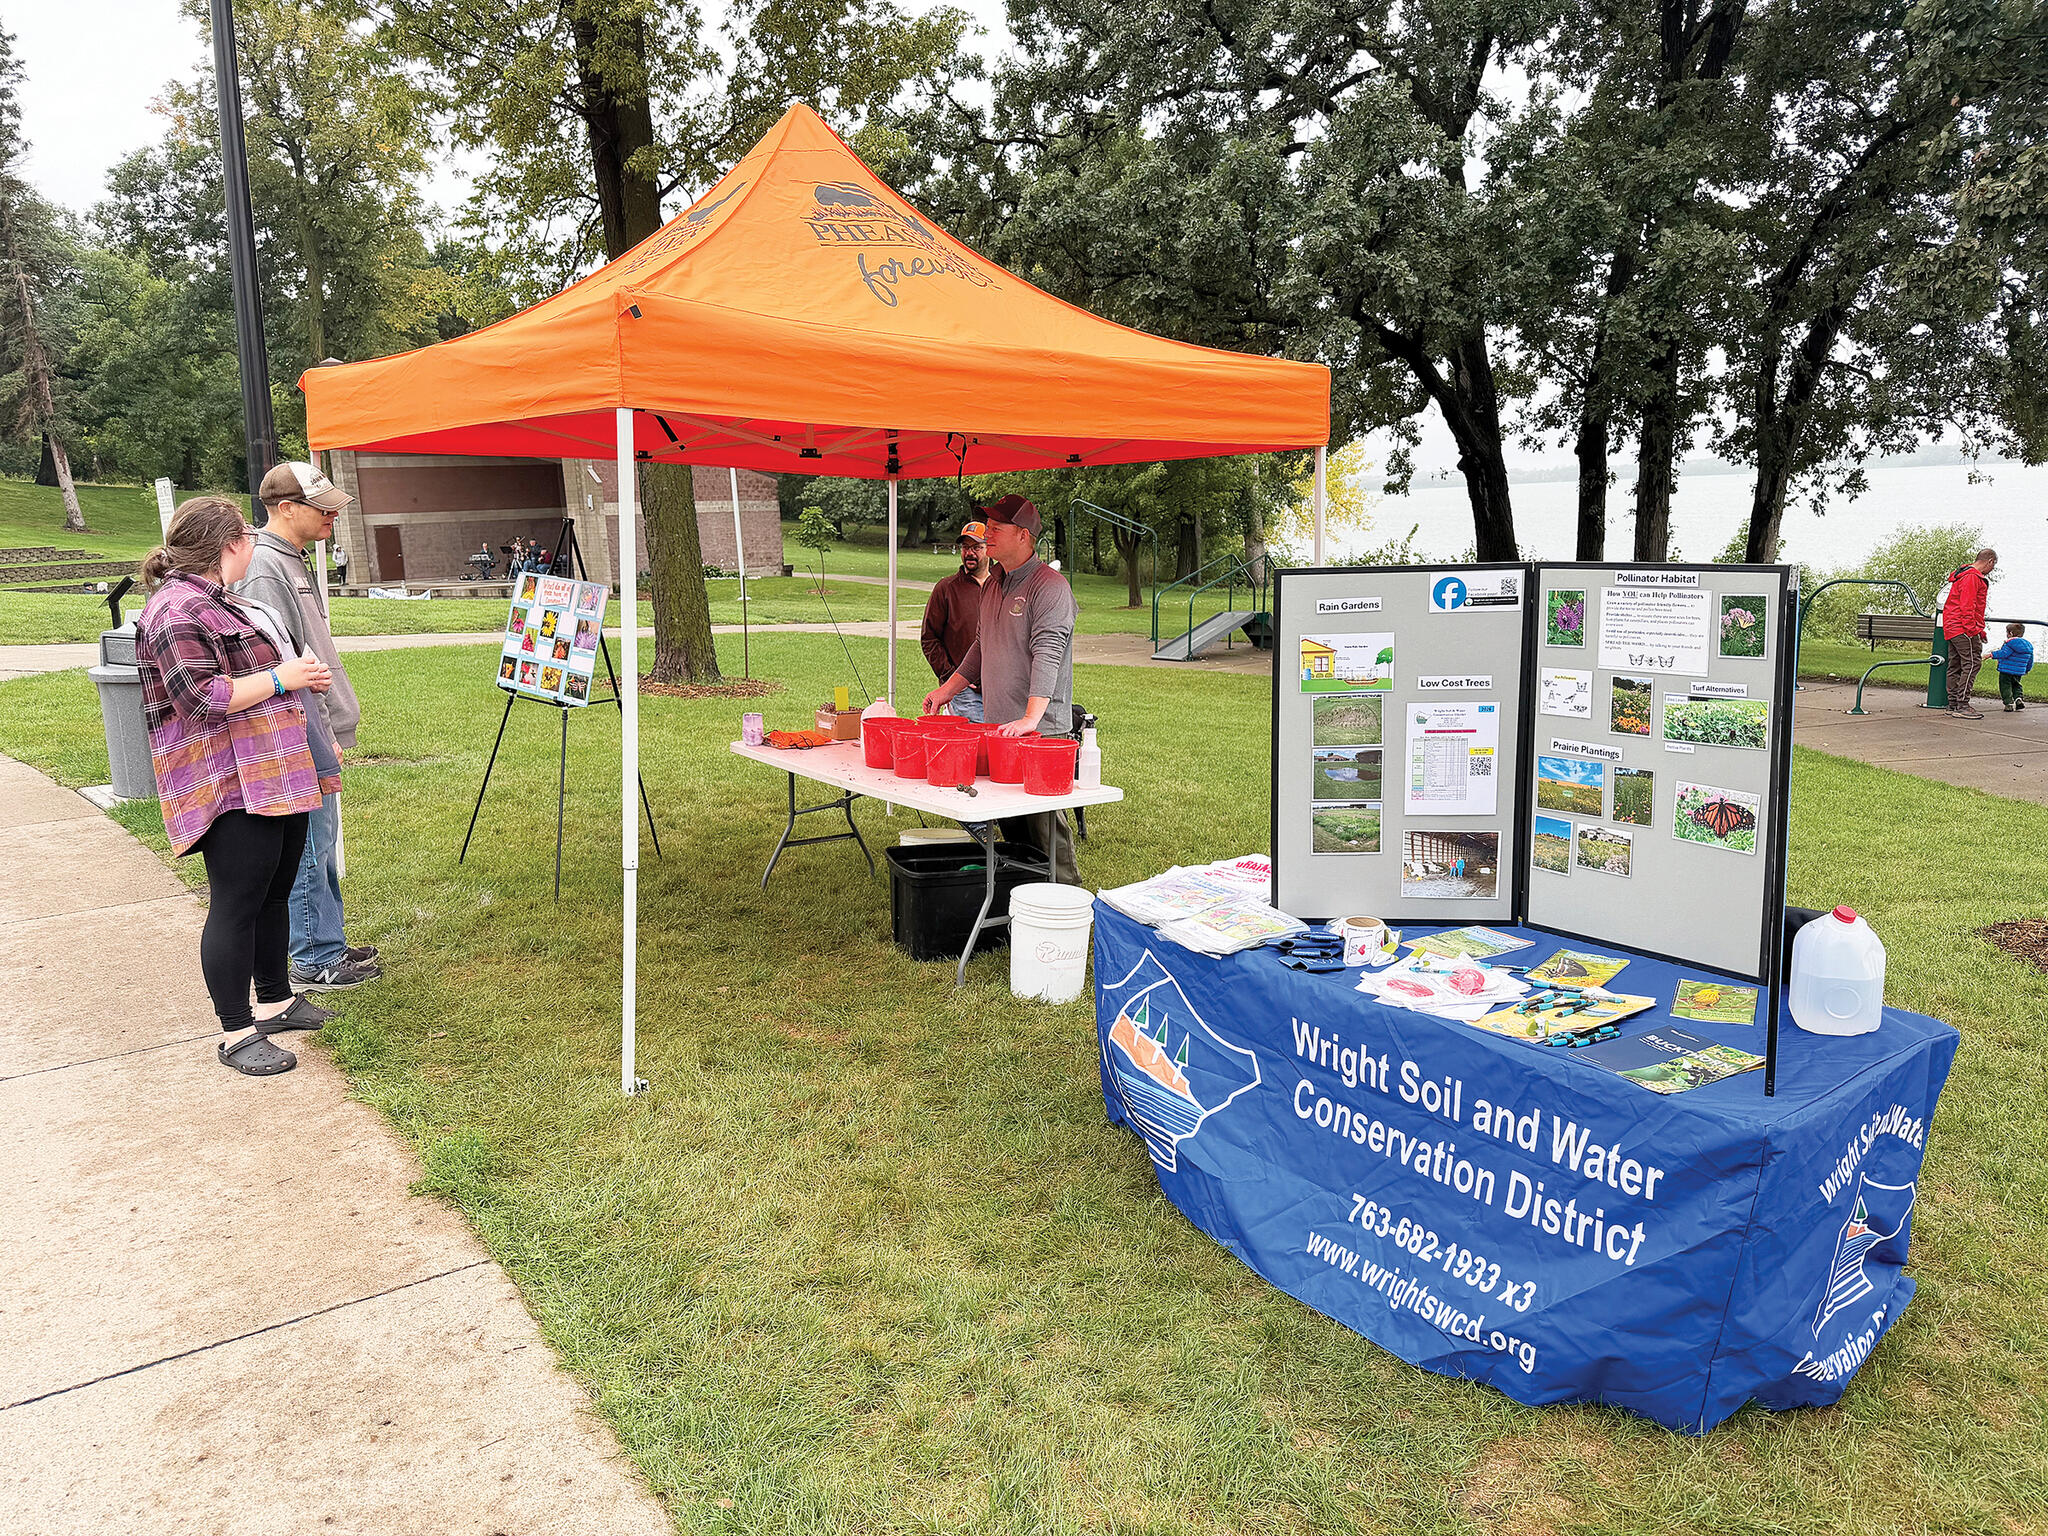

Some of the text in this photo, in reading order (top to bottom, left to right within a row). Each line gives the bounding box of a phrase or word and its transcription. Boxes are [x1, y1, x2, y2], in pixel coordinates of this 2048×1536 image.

[1616, 573, 1697, 585] Pollinator Habitat
[1622, 590, 1639, 598] YOU
[1652, 592, 1668, 600] Help
[1319, 600, 1380, 612] Rain Gardens
[1420, 678, 1491, 688] Low Cost Trees
[1705, 686, 1745, 694] Alternatives
[1553, 740, 1620, 760] Prairie Plantings
[314, 968, 340, 984] N
[1646, 1034, 1737, 1070] BUCKTHORN
[1291, 1016, 1665, 1201] Wright Soil and Water
[1818, 1135, 1861, 1205] Wright
[1886, 1103, 1924, 1151] Wate
[1293, 1079, 1647, 1267] Conservation District
[1347, 1193, 1538, 1313] 763-682-1933 x3
[1306, 1230, 1537, 1375] www.wrightswcd.org
